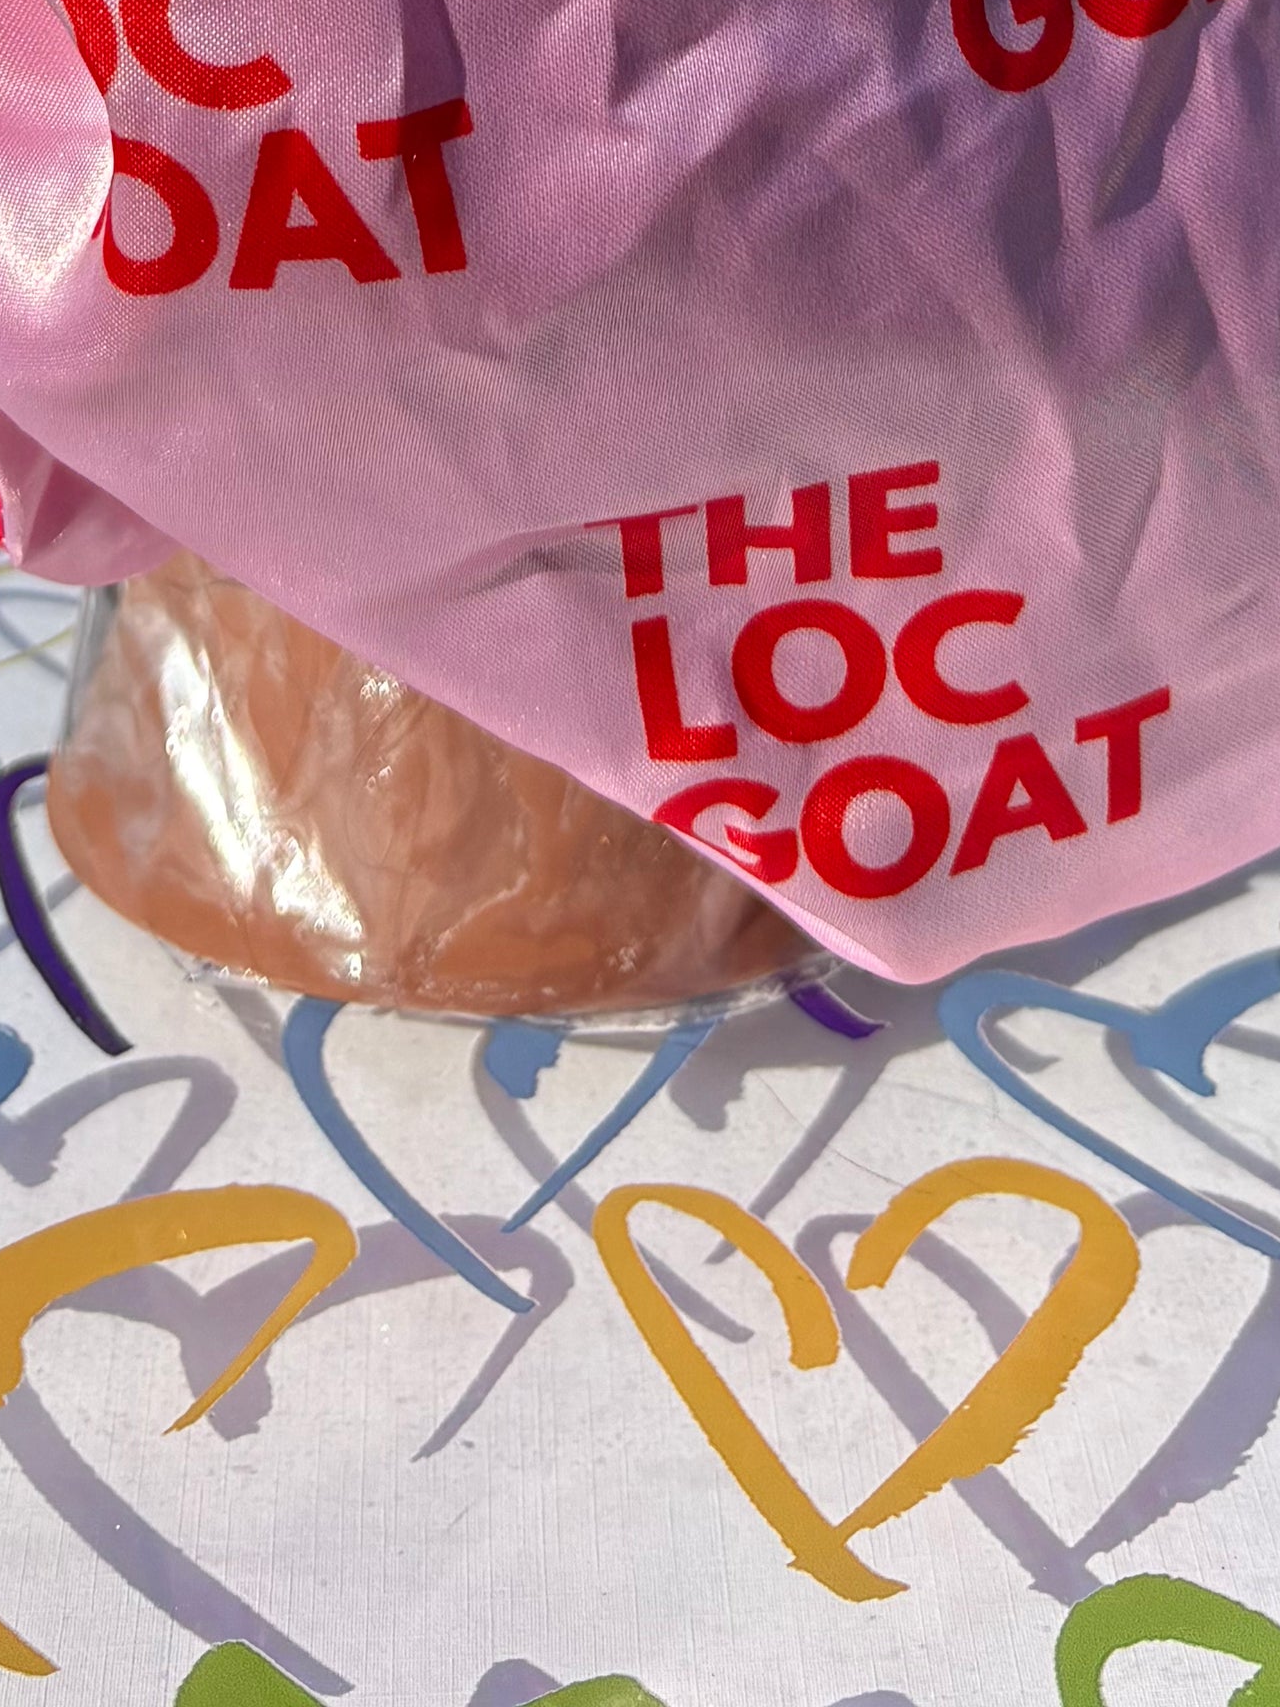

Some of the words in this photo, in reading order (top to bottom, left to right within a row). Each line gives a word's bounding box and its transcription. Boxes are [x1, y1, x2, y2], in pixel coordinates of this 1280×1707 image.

[96, 99, 473, 297] OAT
[583, 460, 943, 599] THE
[631, 589, 1030, 763] LOC
[652, 685, 1171, 900] GOAT
